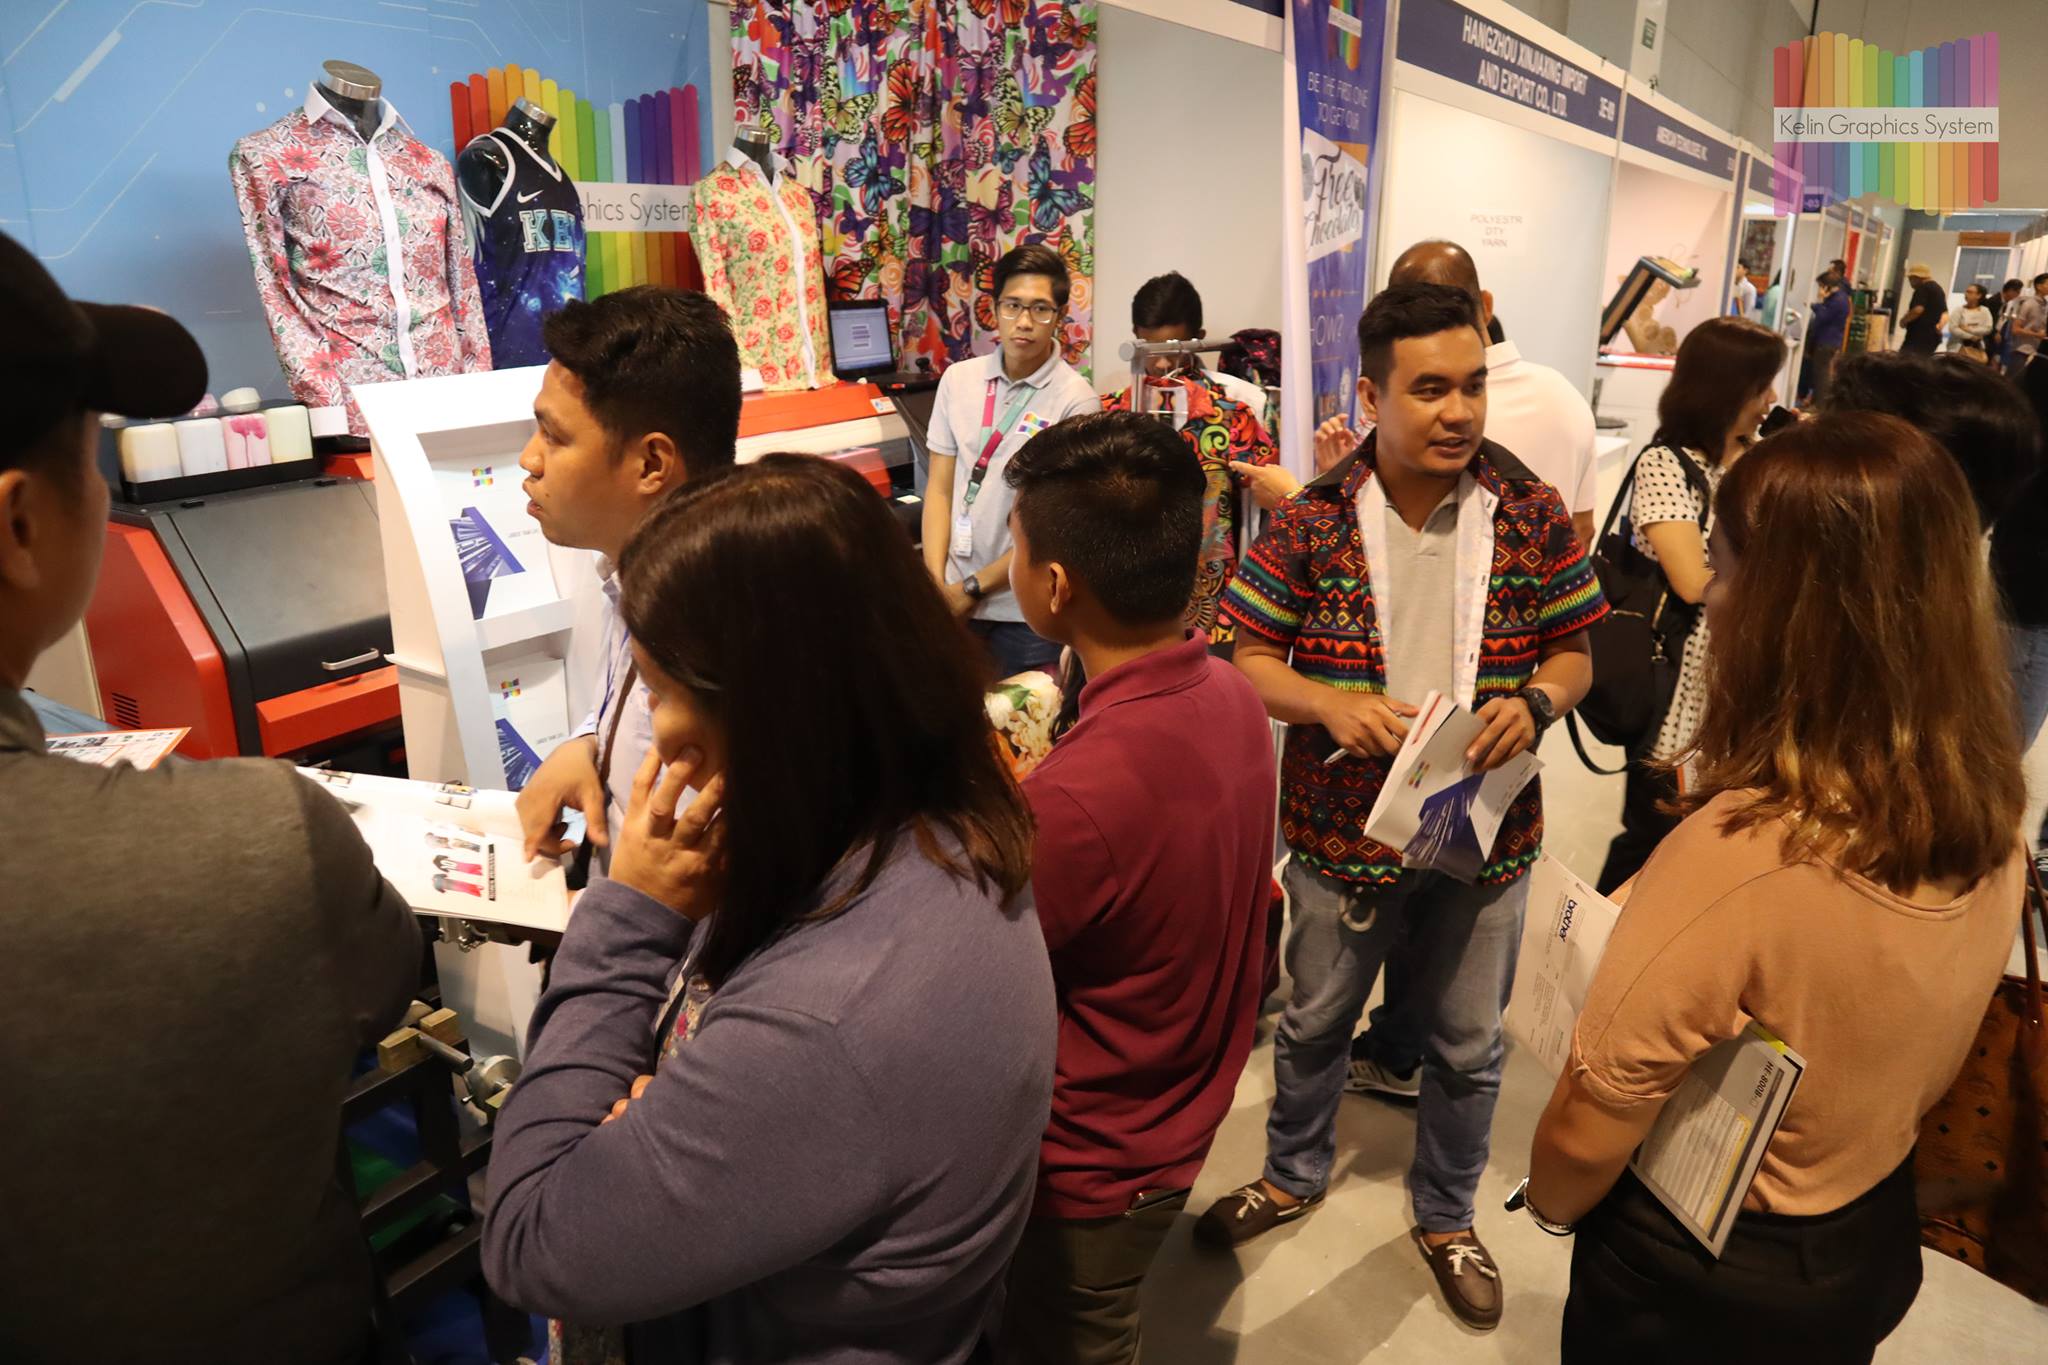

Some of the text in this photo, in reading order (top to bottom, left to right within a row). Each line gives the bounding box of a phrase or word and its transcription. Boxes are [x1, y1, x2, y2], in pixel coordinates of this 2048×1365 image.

[1462, 14, 1519, 64] HANGZHOU
[1308, 71, 1320, 93] BE
[1477, 59, 1500, 91] AND
[1500, 68, 1536, 104] EXPORT
[1313, 144, 1356, 222] Free
[1559, 899, 1578, 943] brother
